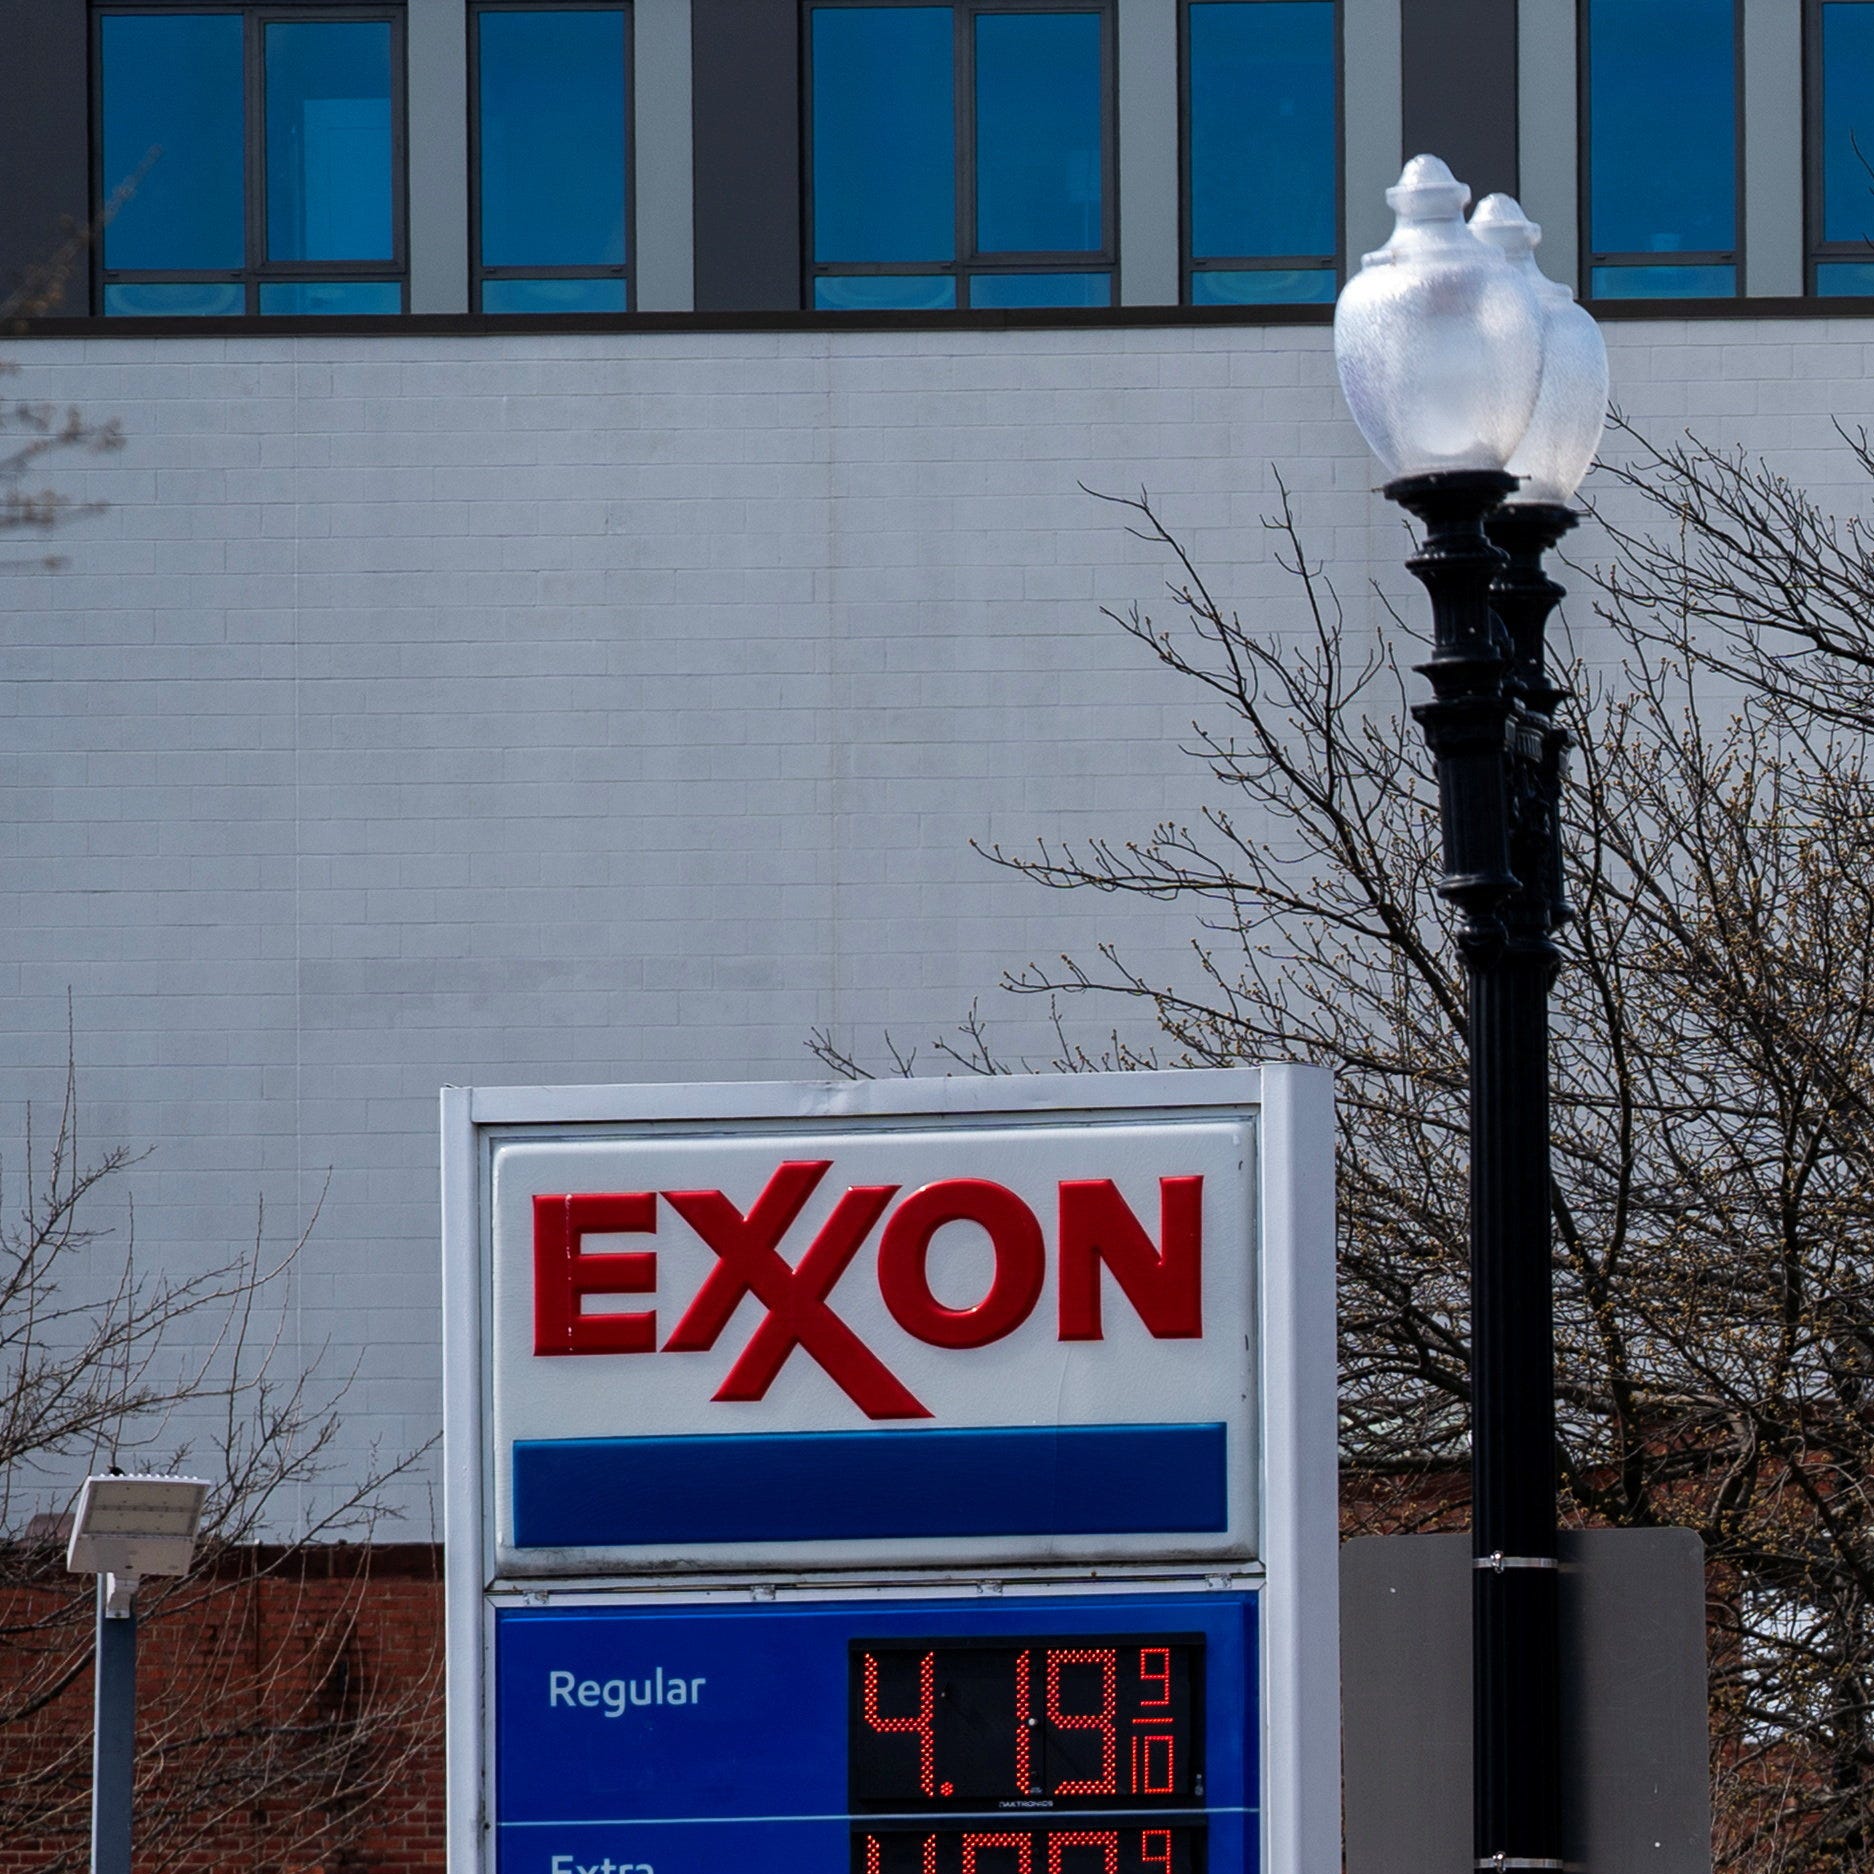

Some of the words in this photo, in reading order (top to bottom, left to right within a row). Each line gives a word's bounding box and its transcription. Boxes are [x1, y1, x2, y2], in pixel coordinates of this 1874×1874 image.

[532, 1160, 1204, 1420] EXXON
[550, 1666, 706, 1718] Regular
[865, 1649, 1116, 1797] 4.19
